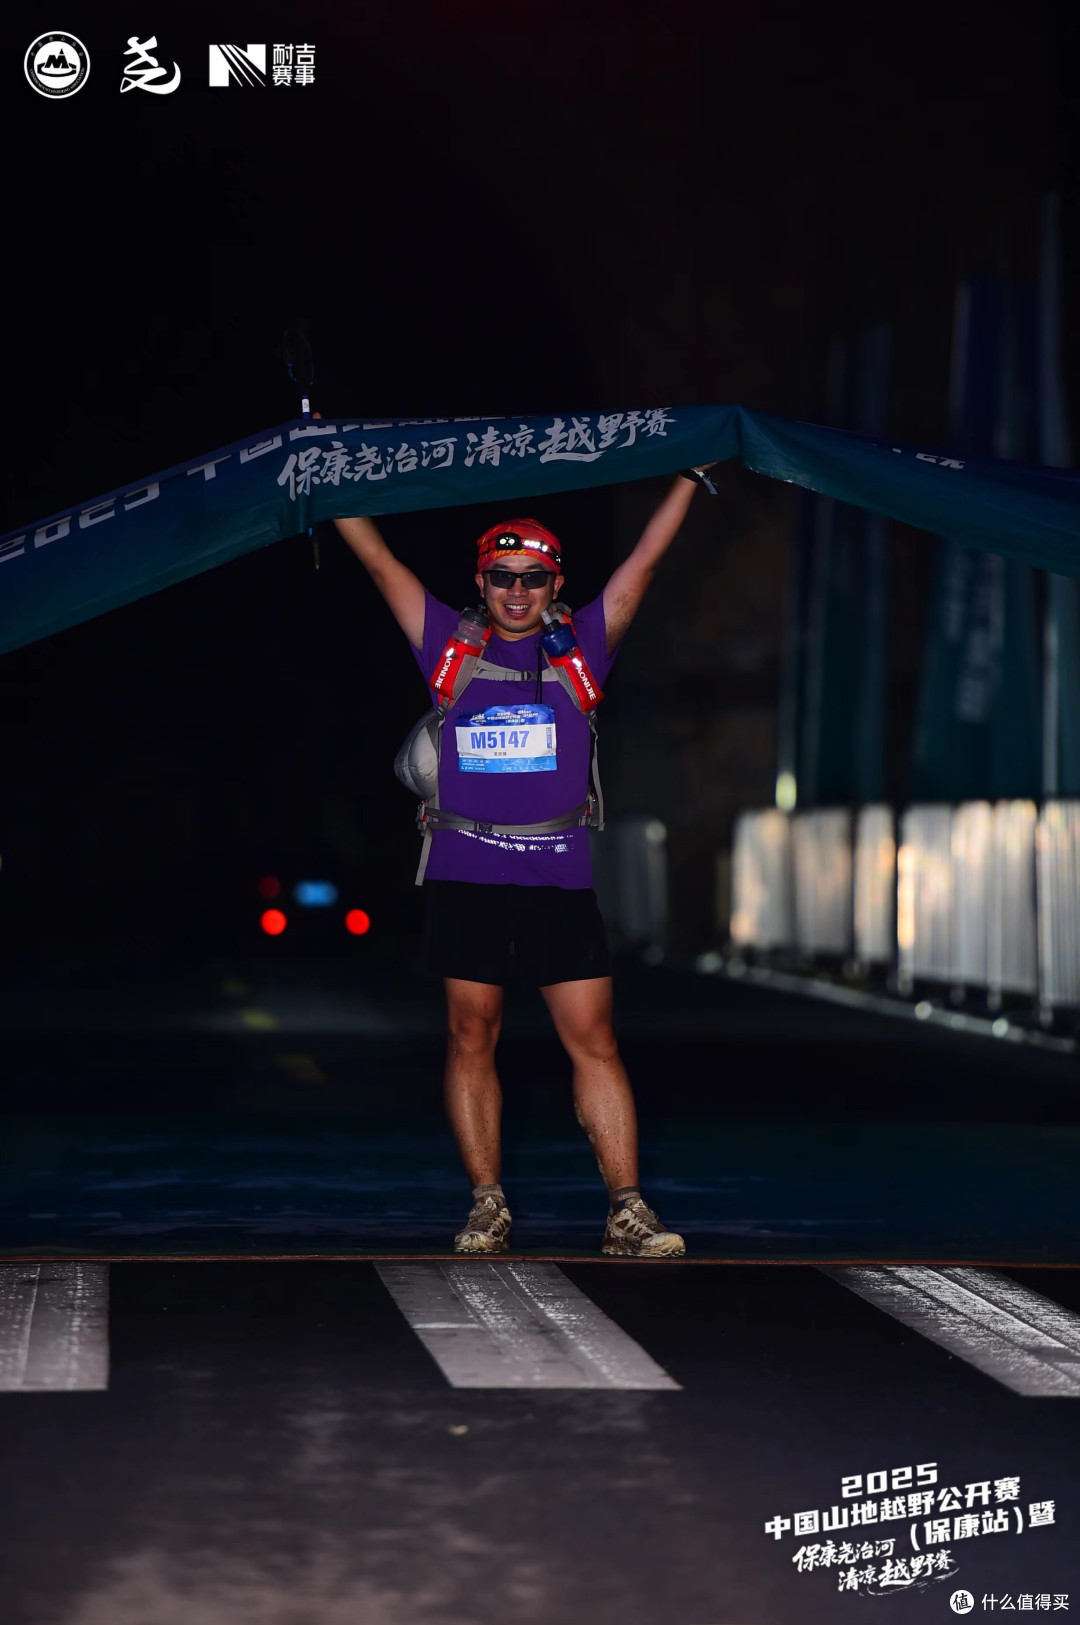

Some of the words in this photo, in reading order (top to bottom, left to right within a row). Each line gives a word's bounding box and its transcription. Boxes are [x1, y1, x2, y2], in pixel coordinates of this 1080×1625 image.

[277, 436, 457, 502] 保康尧治河
[463, 406, 678, 467] 清凉越野赛
[470, 730, 530, 750] M5147
